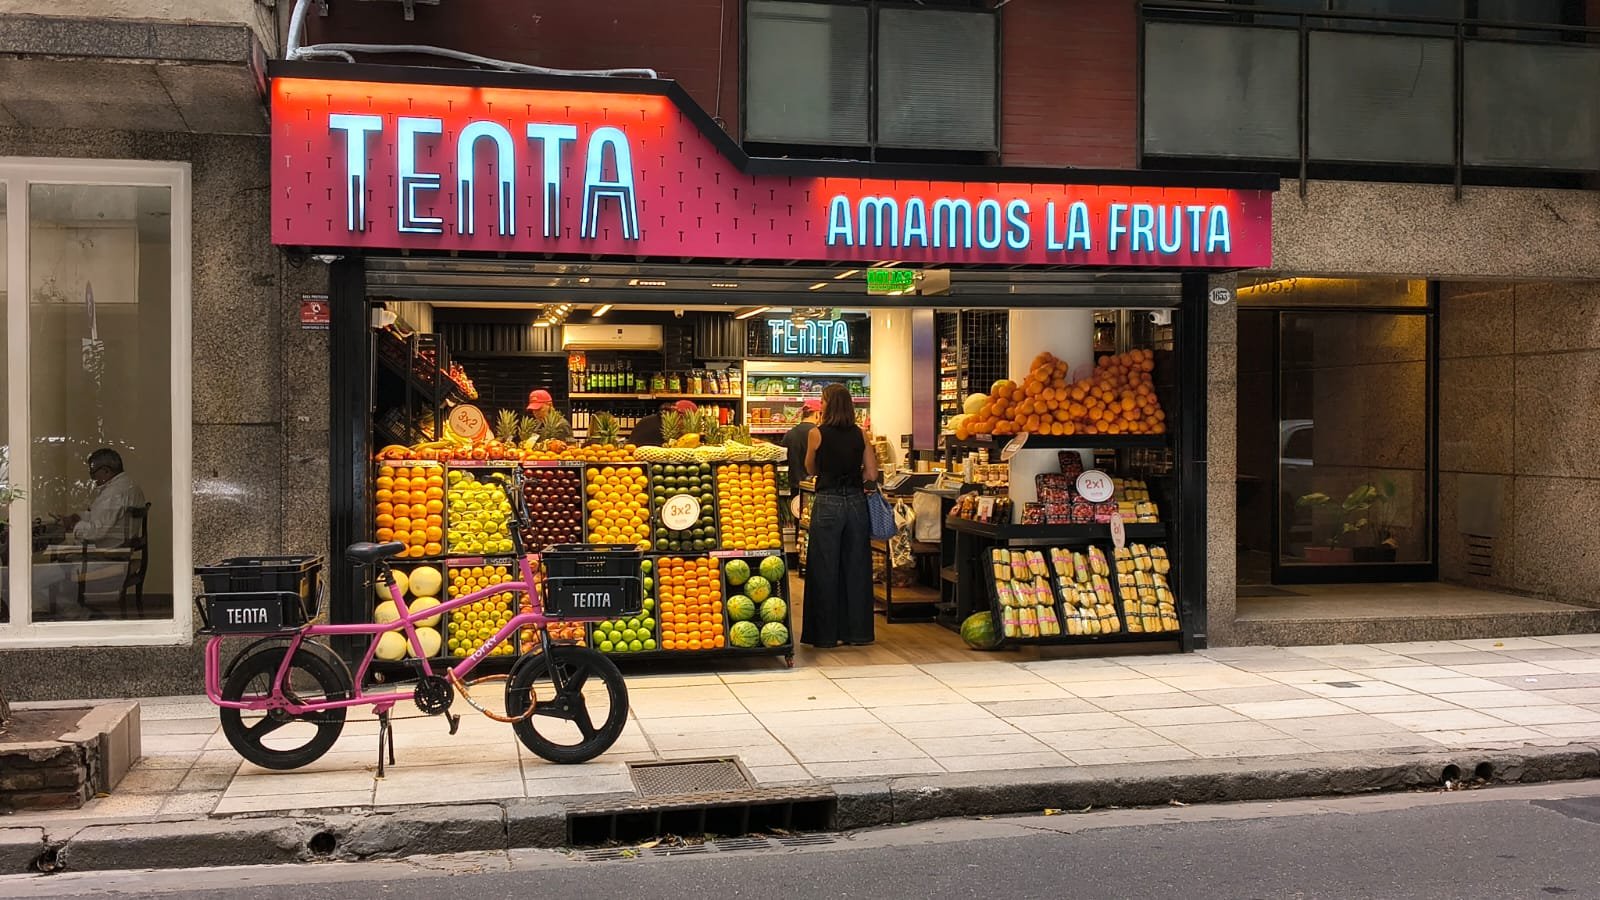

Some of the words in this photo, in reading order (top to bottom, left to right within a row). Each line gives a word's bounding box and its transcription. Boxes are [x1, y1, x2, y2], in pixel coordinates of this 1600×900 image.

[329, 113, 639, 240] TENTA
[827, 195, 1031, 250] AMAMOS
[1046, 201, 1091, 252] LA
[1108, 203, 1231, 255] FRUTA
[768, 320, 849, 354] TENTA
[1085, 478, 1104, 489] 2x1
[671, 503, 692, 517] 3x2
[571, 592, 611, 608] TENTA
[226, 607, 268, 624] TENTA
